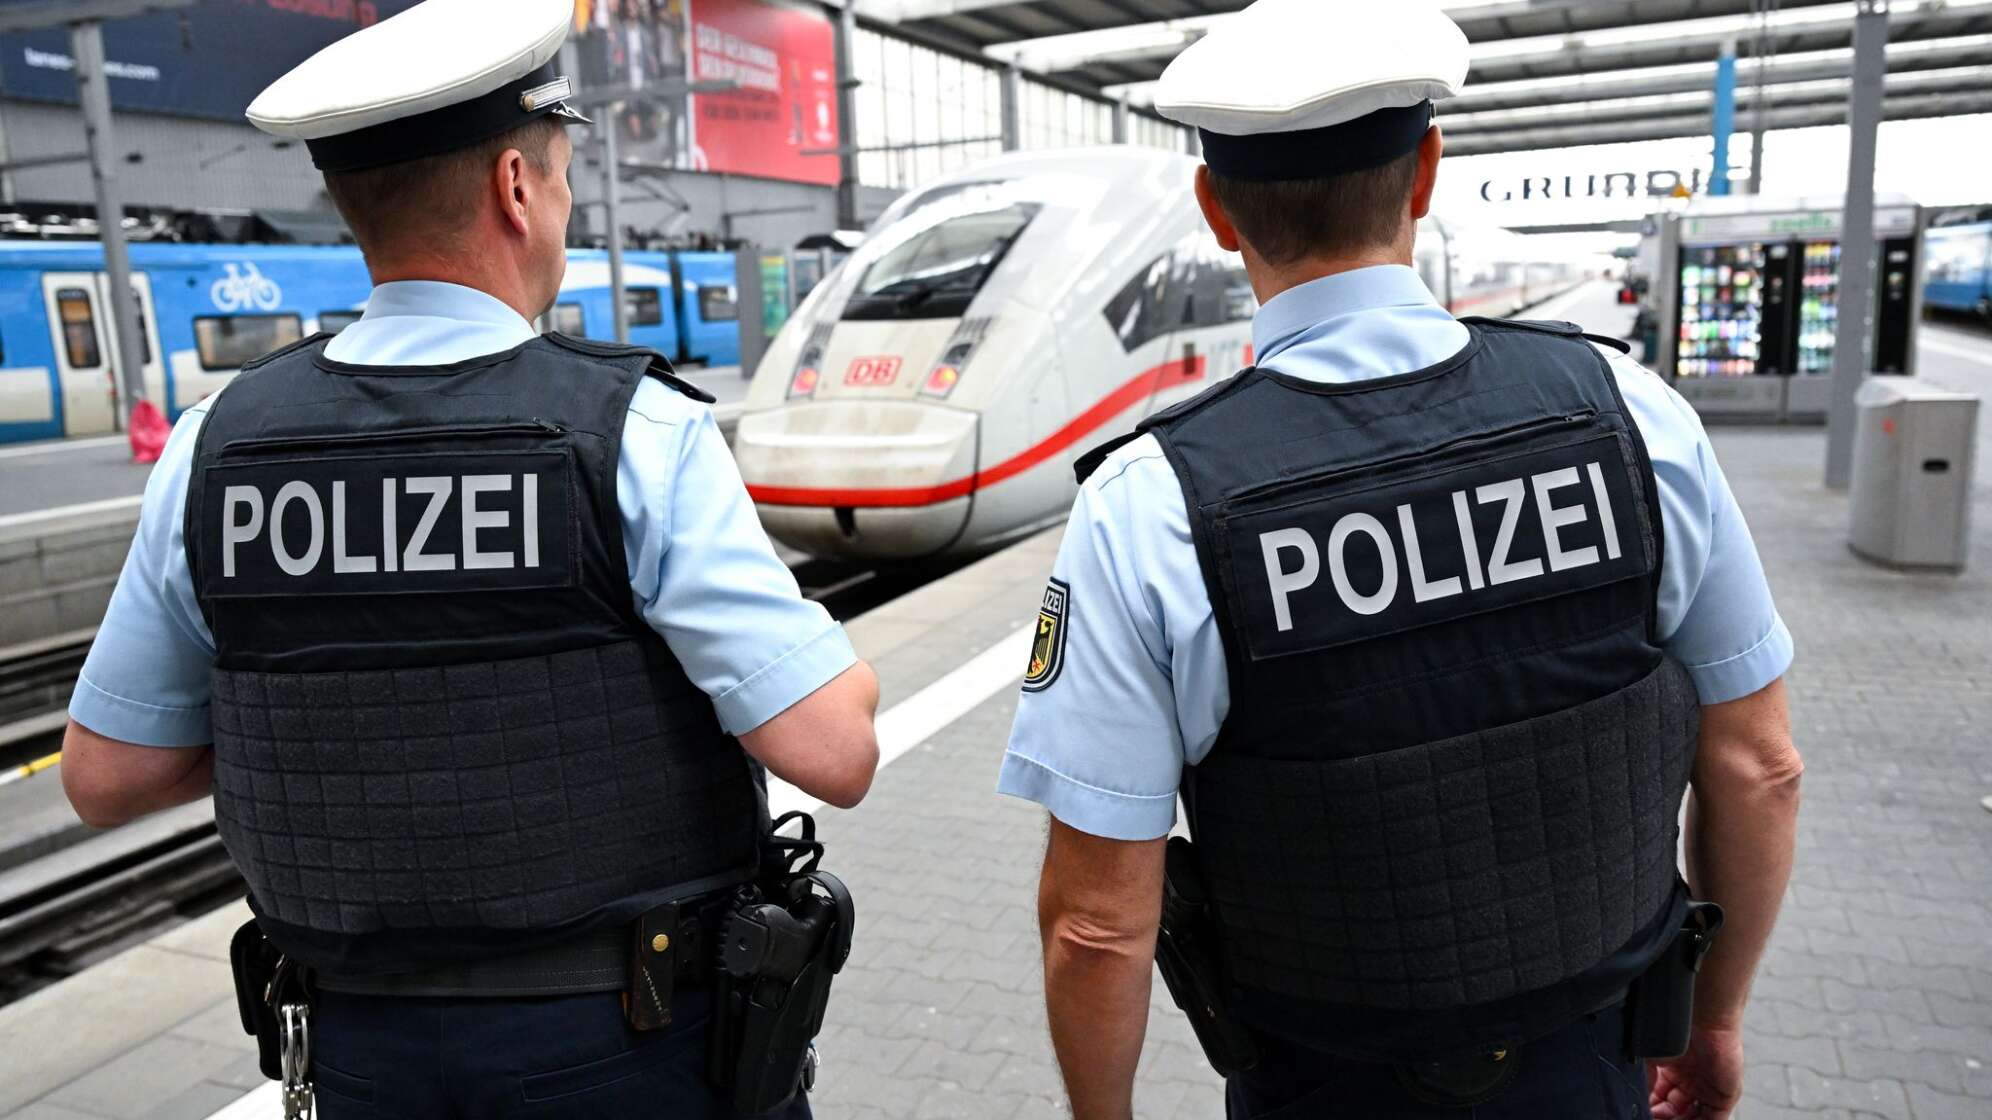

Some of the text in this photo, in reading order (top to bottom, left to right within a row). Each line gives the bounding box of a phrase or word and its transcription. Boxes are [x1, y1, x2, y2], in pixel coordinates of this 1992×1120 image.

[1479, 167, 1701, 200] GRUNDI
[847, 358, 893, 382] DB
[223, 473, 540, 578] POLIZEI
[1259, 462, 1622, 632] POLIZEI
[1042, 589, 1062, 614] IZEI
